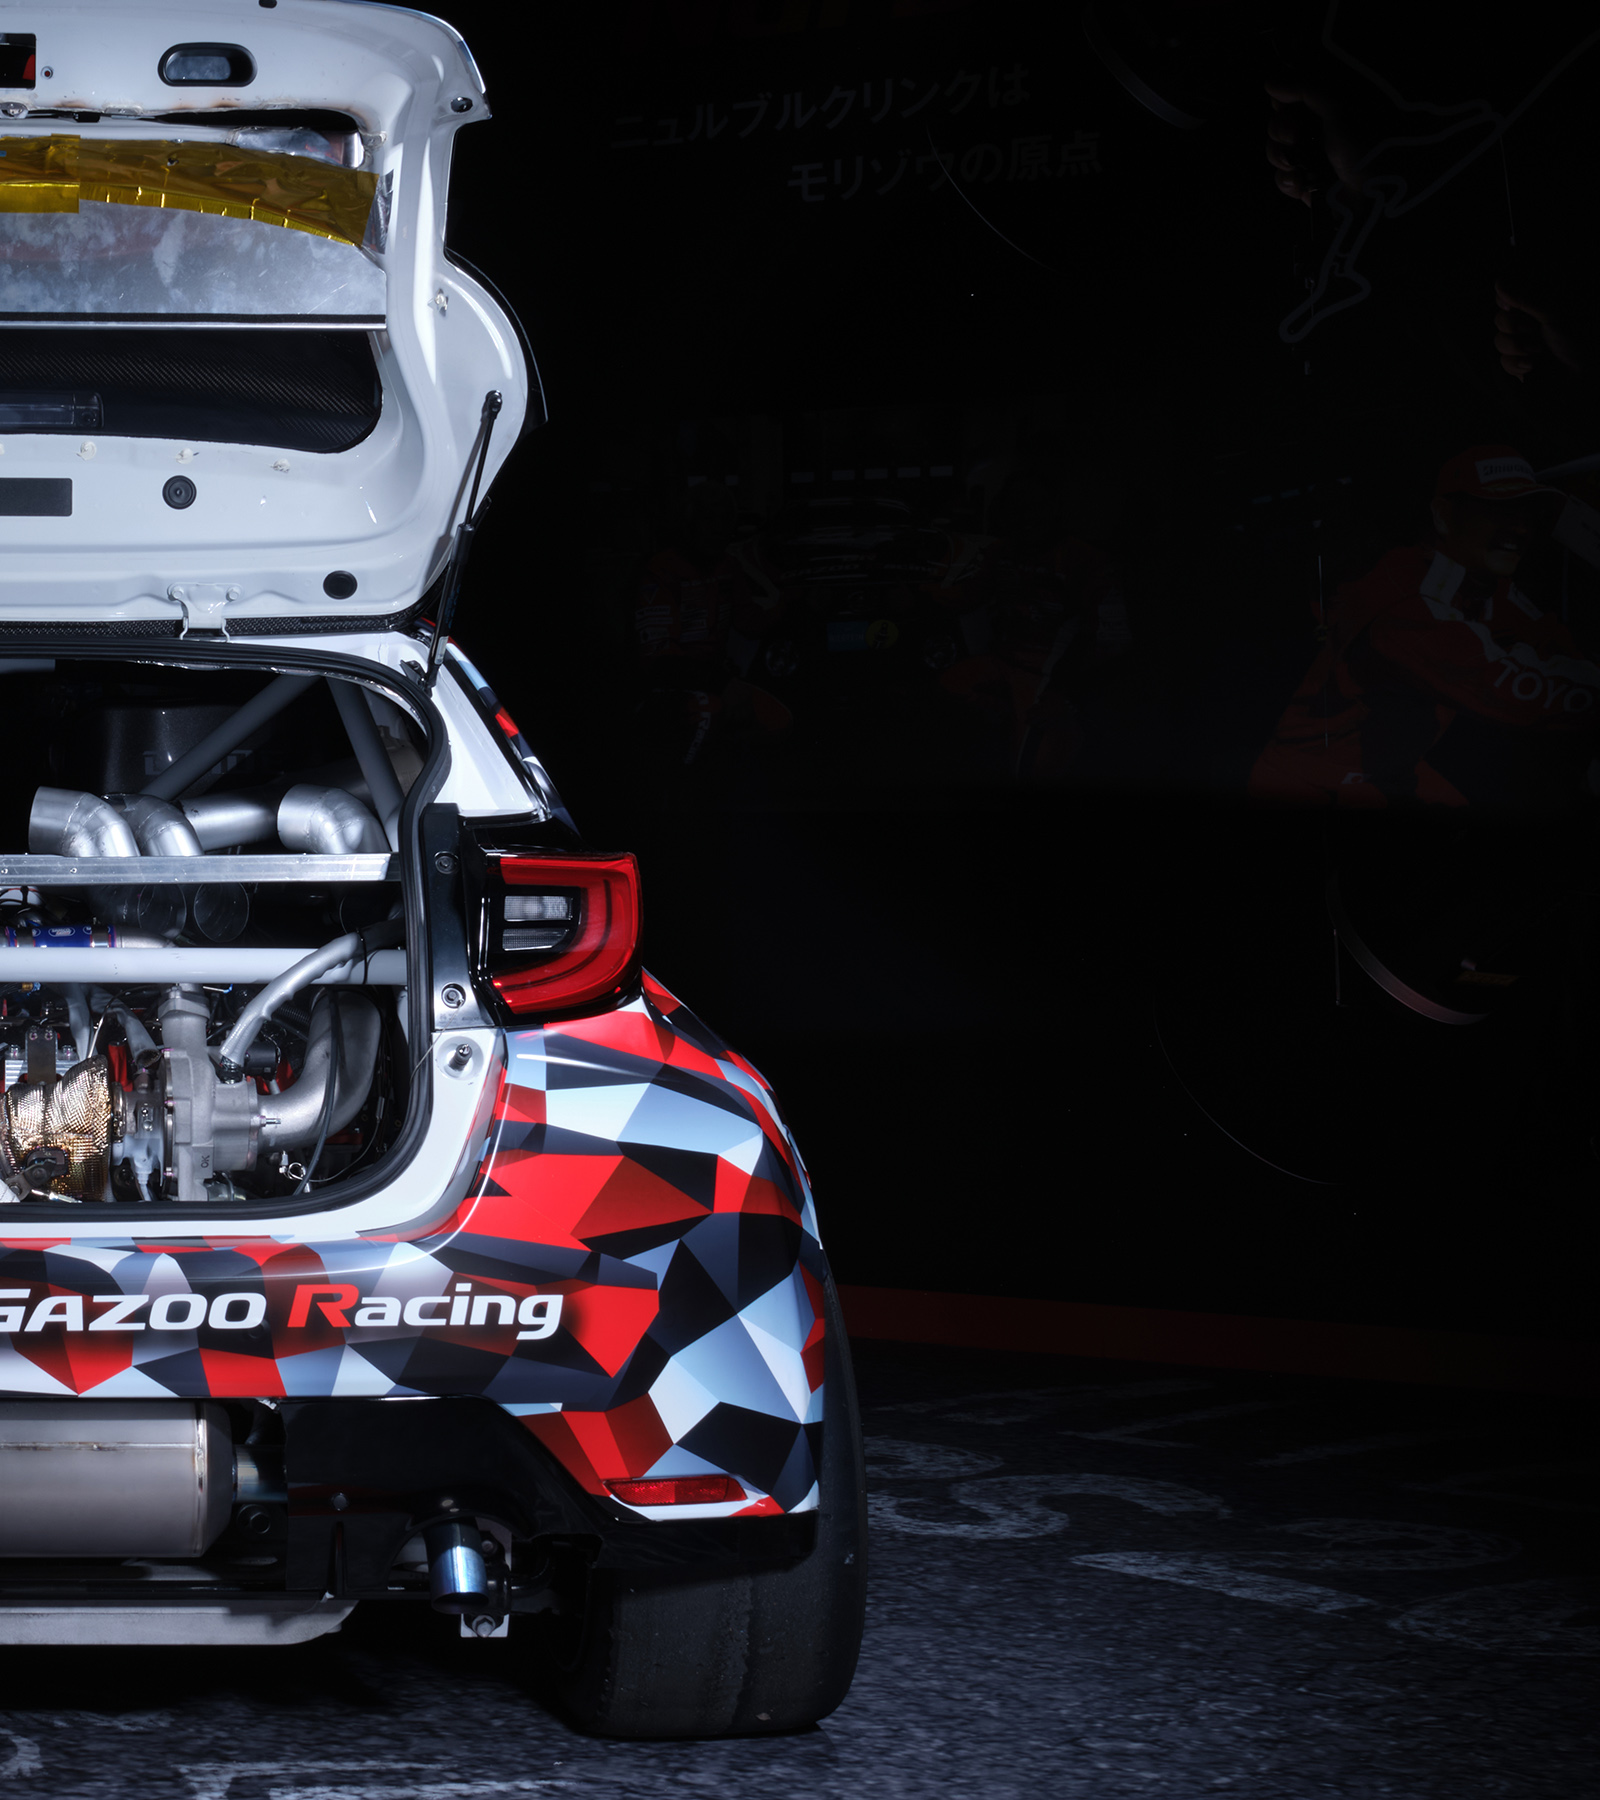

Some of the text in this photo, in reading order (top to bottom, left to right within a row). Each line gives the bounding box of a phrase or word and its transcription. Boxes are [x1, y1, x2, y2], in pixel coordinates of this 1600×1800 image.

[609, 62, 1031, 149] ニュルブルクリンクは
[788, 129, 1104, 203] モリゾウの原点
[201, 1155, 210, 1168] OK
[287, 1283, 564, 1341] Racing
